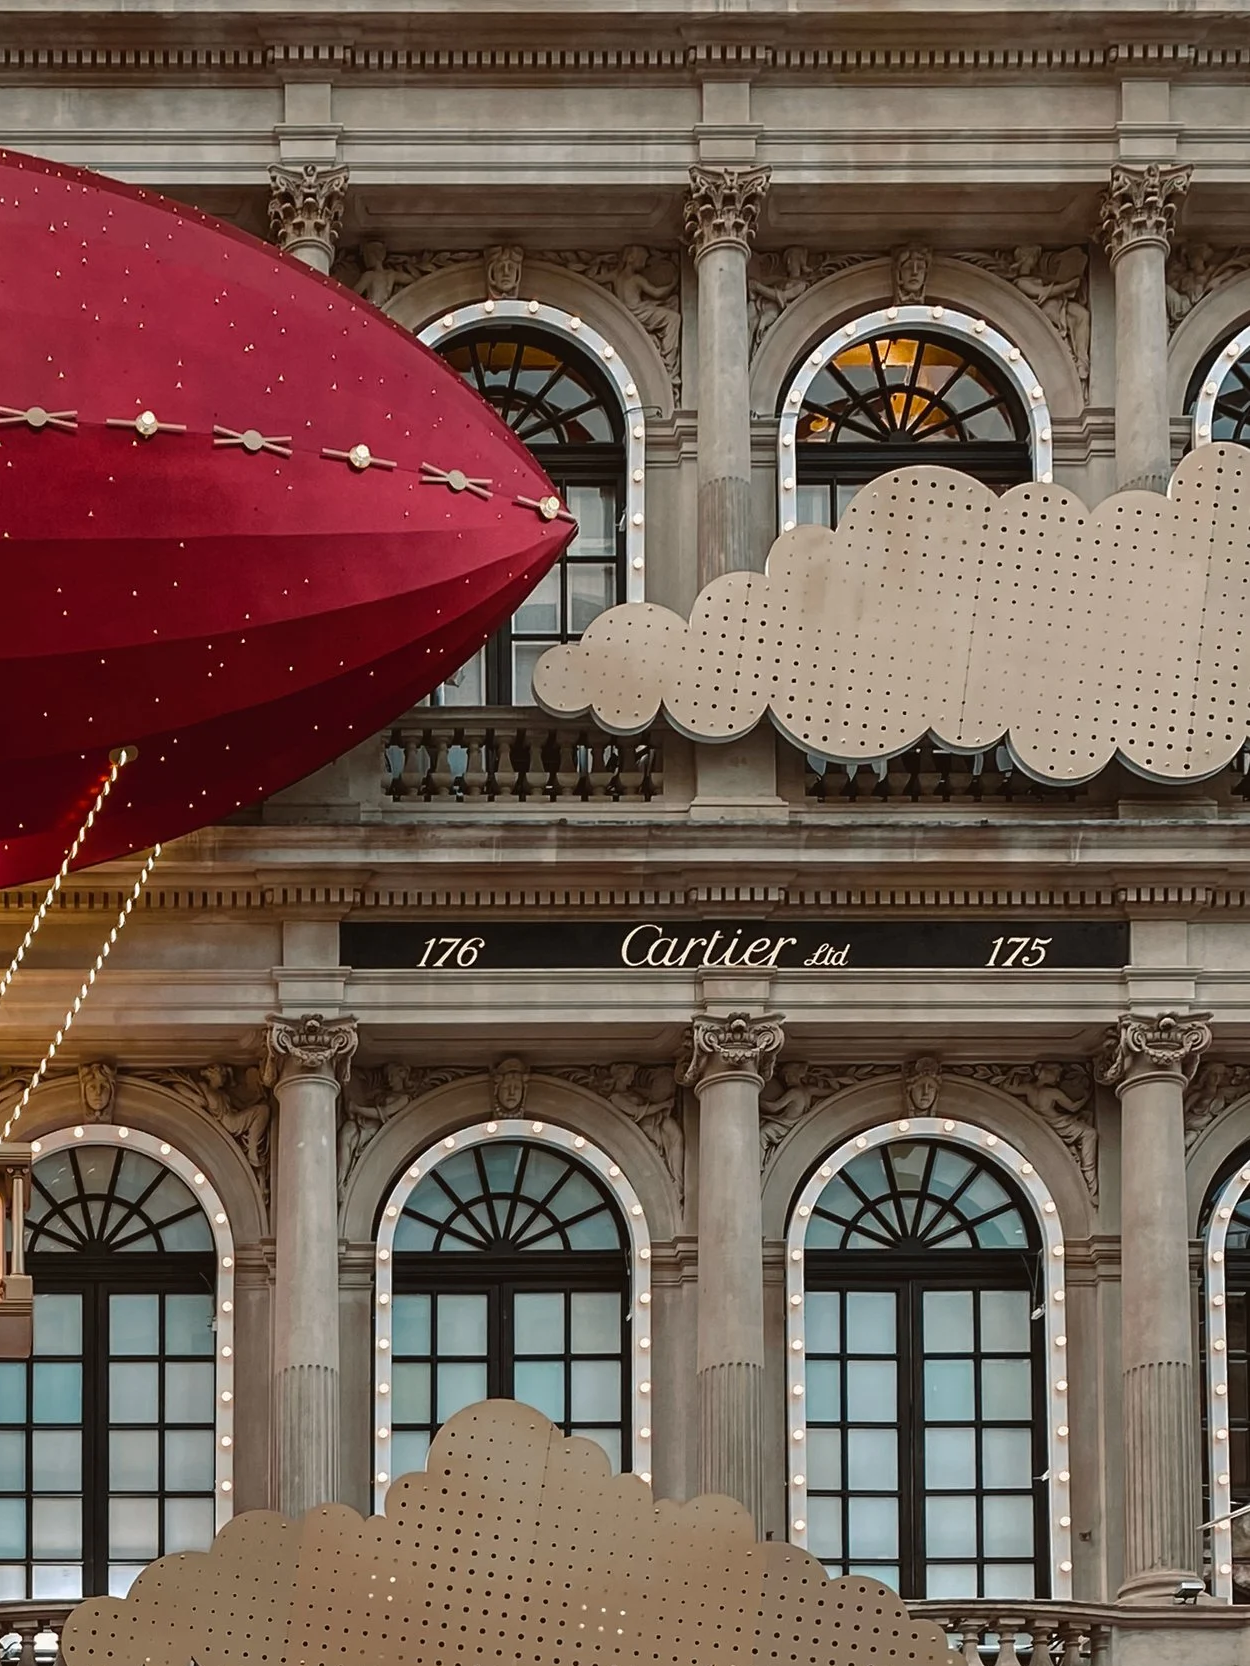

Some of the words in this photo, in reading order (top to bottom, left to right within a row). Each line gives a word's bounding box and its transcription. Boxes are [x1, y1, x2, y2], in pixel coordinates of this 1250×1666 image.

[416, 937, 485, 967] 176
[621, 924, 797, 967] Cartier
[804, 943, 850, 967] Ltd
[985, 937, 1052, 967] 175
